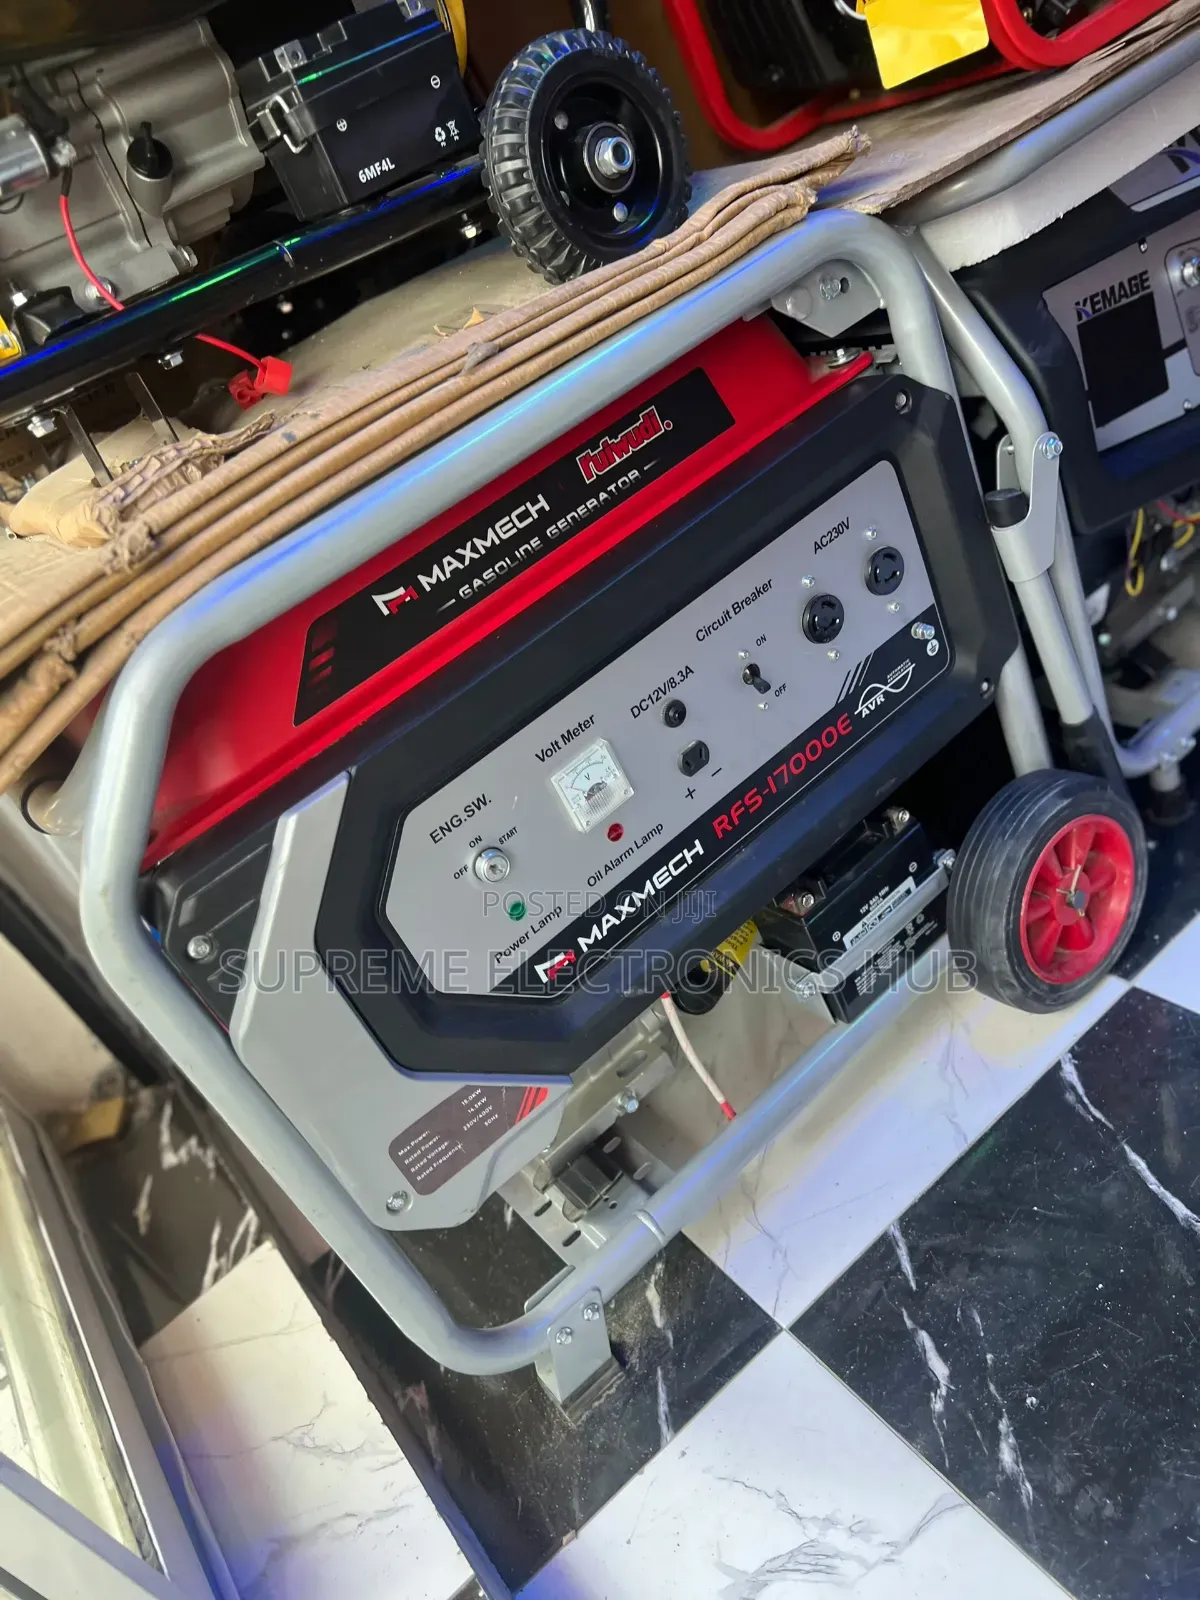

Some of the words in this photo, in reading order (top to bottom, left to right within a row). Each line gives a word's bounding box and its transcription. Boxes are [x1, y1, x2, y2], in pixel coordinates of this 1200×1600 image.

[358, 157, 395, 184] 6MF4L
[1074, 270, 1151, 322] KEMAGE
[417, 493, 551, 592] MAXMECH
[458, 536, 544, 600] GASOLINE
[546, 469, 642, 540] GENERATOR
[812, 517, 851, 554] AC230V
[695, 609, 733, 643] Circuit
[732, 579, 774, 617] Breaker
[755, 634, 767, 647] ON
[630, 664, 695, 719] DC12V/8.3A
[774, 683, 788, 698] OFF
[861, 693, 885, 718] AVR
[535, 740, 562, 765] Volt
[560, 714, 597, 745] Meter
[429, 793, 492, 845] ENG.SW.
[468, 835, 483, 849] ON
[498, 826, 519, 845] START
[577, 838, 705, 952] MAXMECH
[712, 713, 853, 839] RFS-17000E
[453, 864, 469, 880] OFF
[587, 867, 604, 888] Oil
[603, 847, 635, 876] Alarm
[634, 821, 664, 850] Lamp
[494, 932, 530, 964] Power
[530, 906, 563, 935] Lamp
[404, 1150, 421, 1165] Rated
[410, 1157, 427, 1173] Rated
[416, 1166, 433, 1181] Rated
